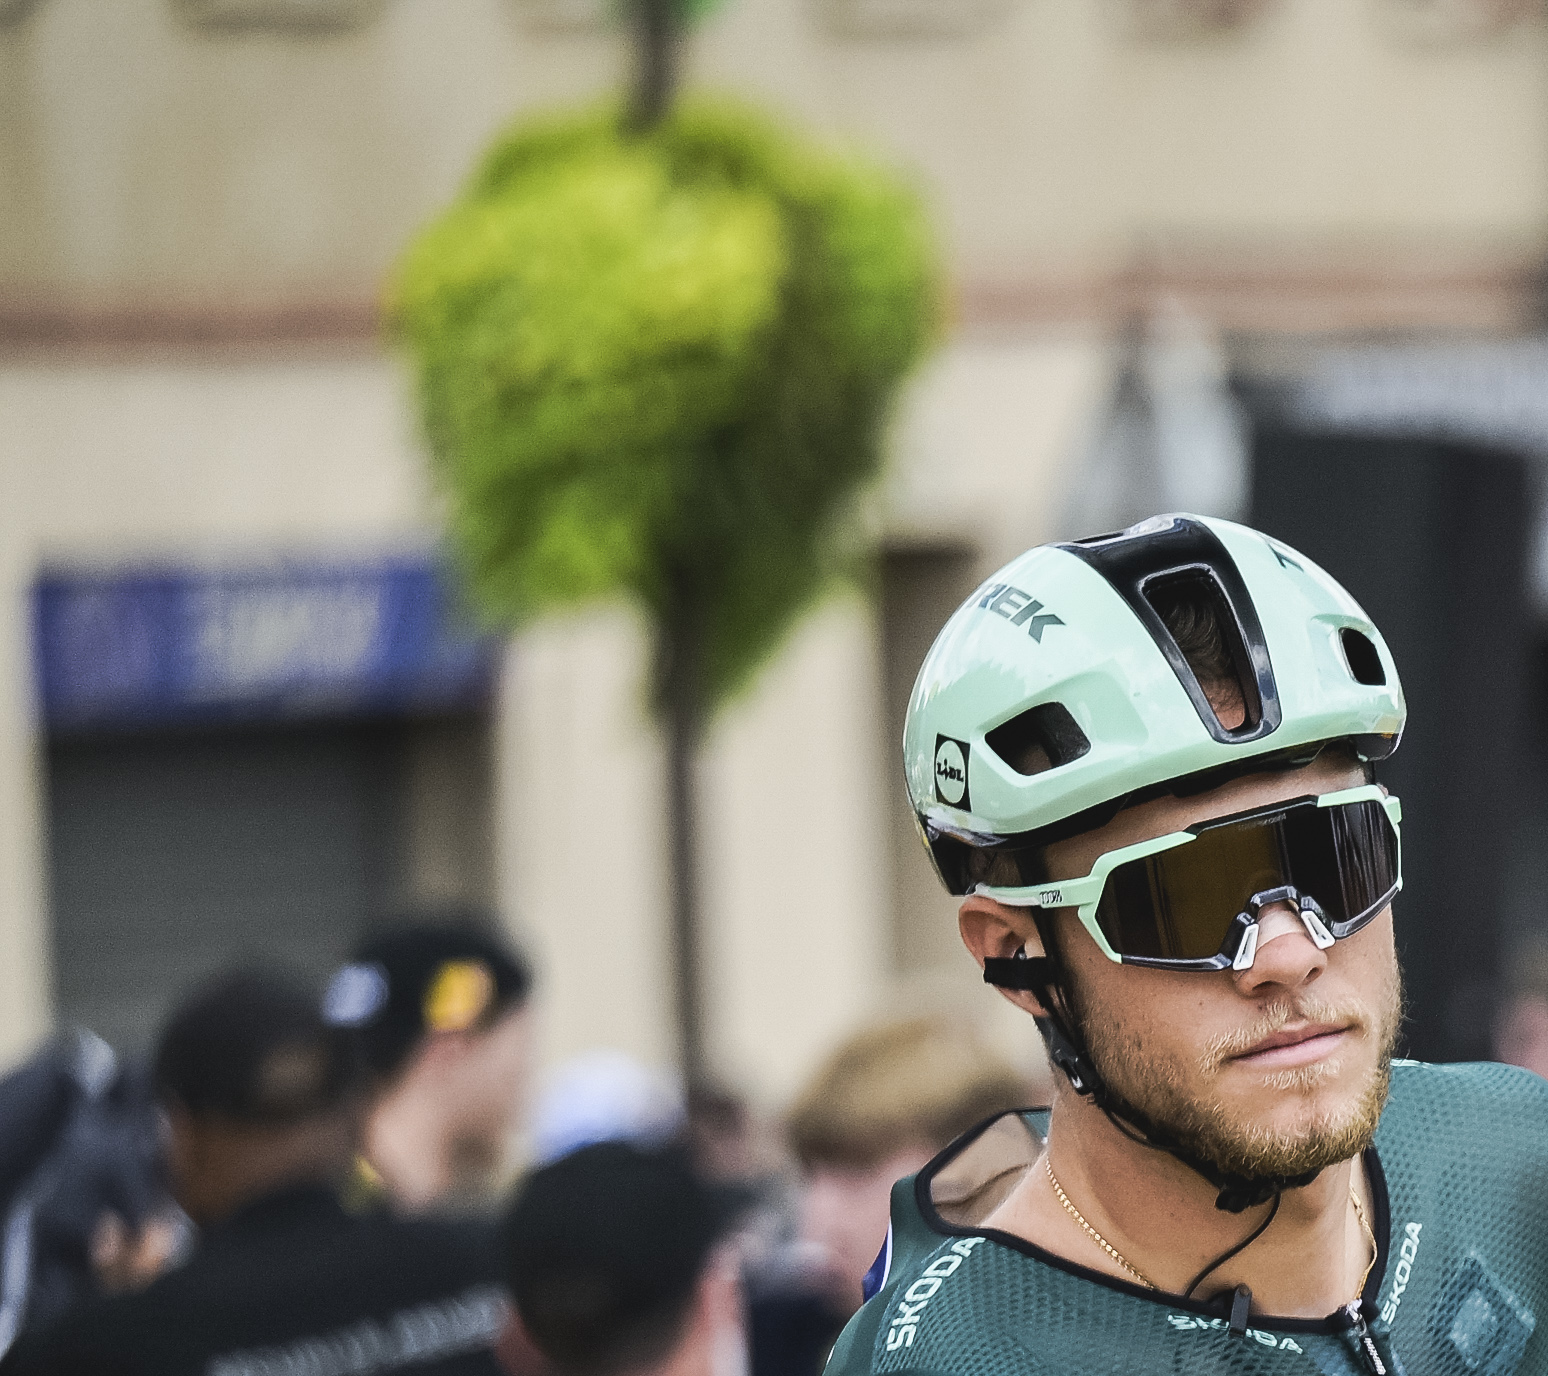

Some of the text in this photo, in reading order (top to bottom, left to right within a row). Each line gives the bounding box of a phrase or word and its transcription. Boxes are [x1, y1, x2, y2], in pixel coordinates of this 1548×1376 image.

[979, 581, 1067, 645] REK
[1039, 889, 1064, 905] 100%
[886, 1236, 987, 1352] SKODA
[1380, 1221, 1423, 1325] SKODA
